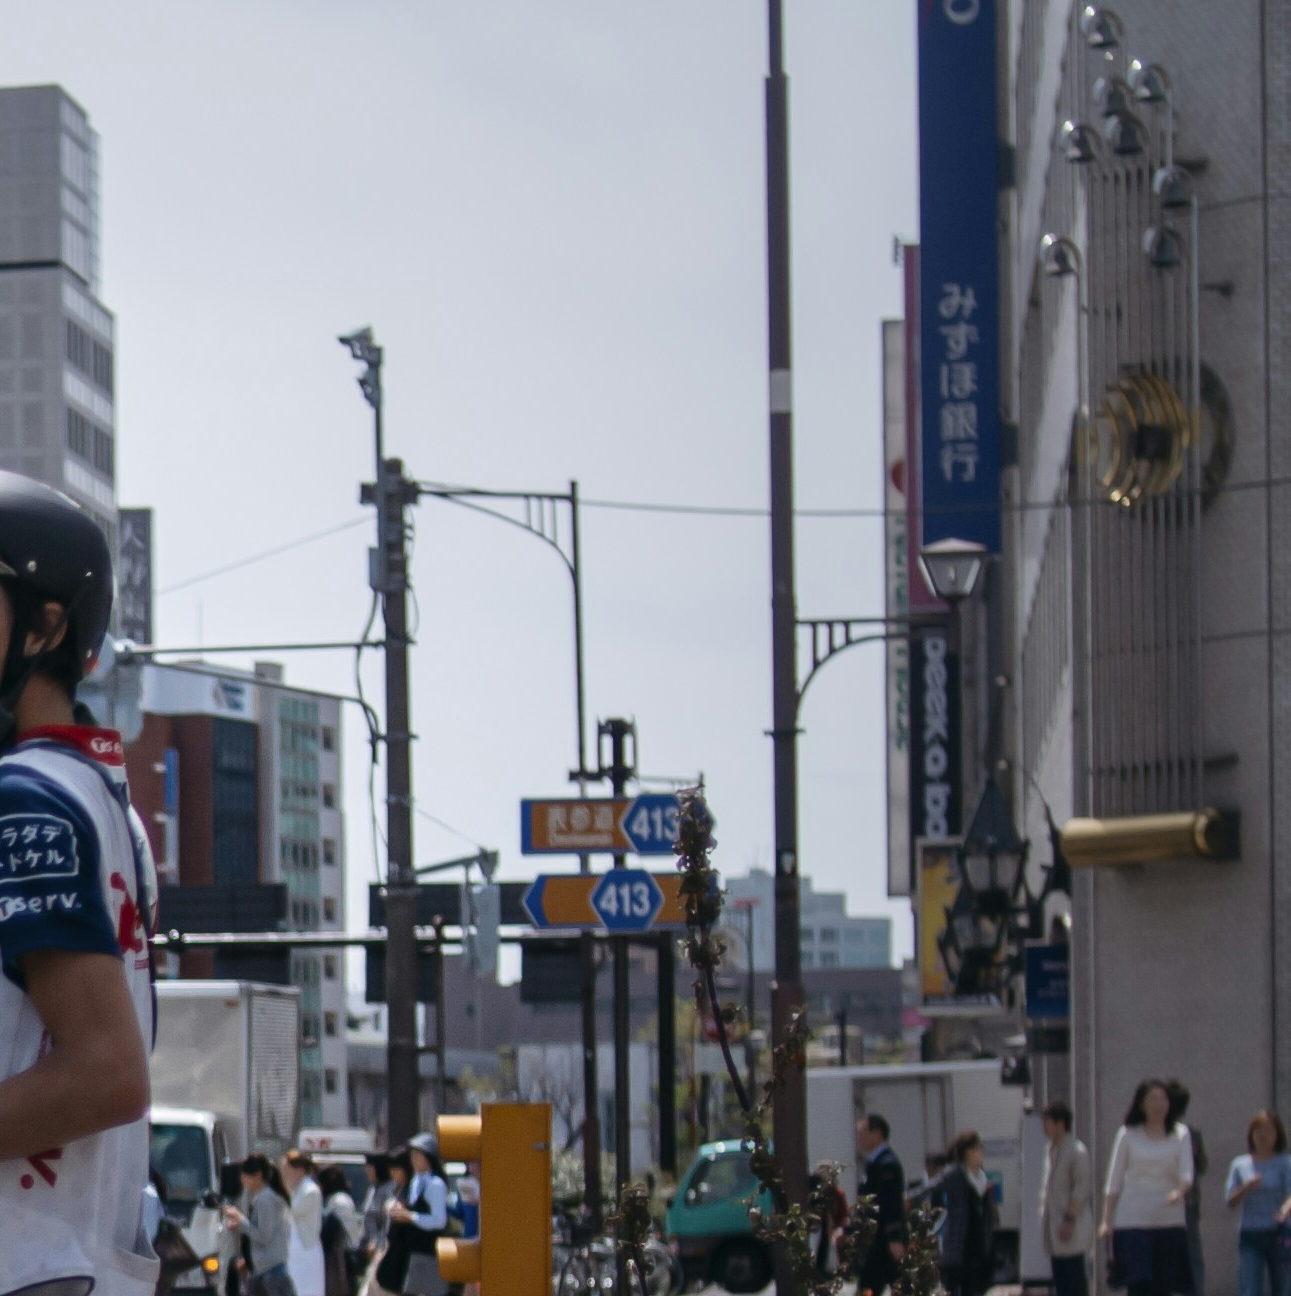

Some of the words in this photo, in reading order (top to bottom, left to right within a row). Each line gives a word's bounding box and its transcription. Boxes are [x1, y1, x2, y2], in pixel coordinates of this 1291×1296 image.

[938, 282, 979, 483] みずほ銀行
[632, 804, 680, 842] 413
[599, 882, 651, 917] 413
